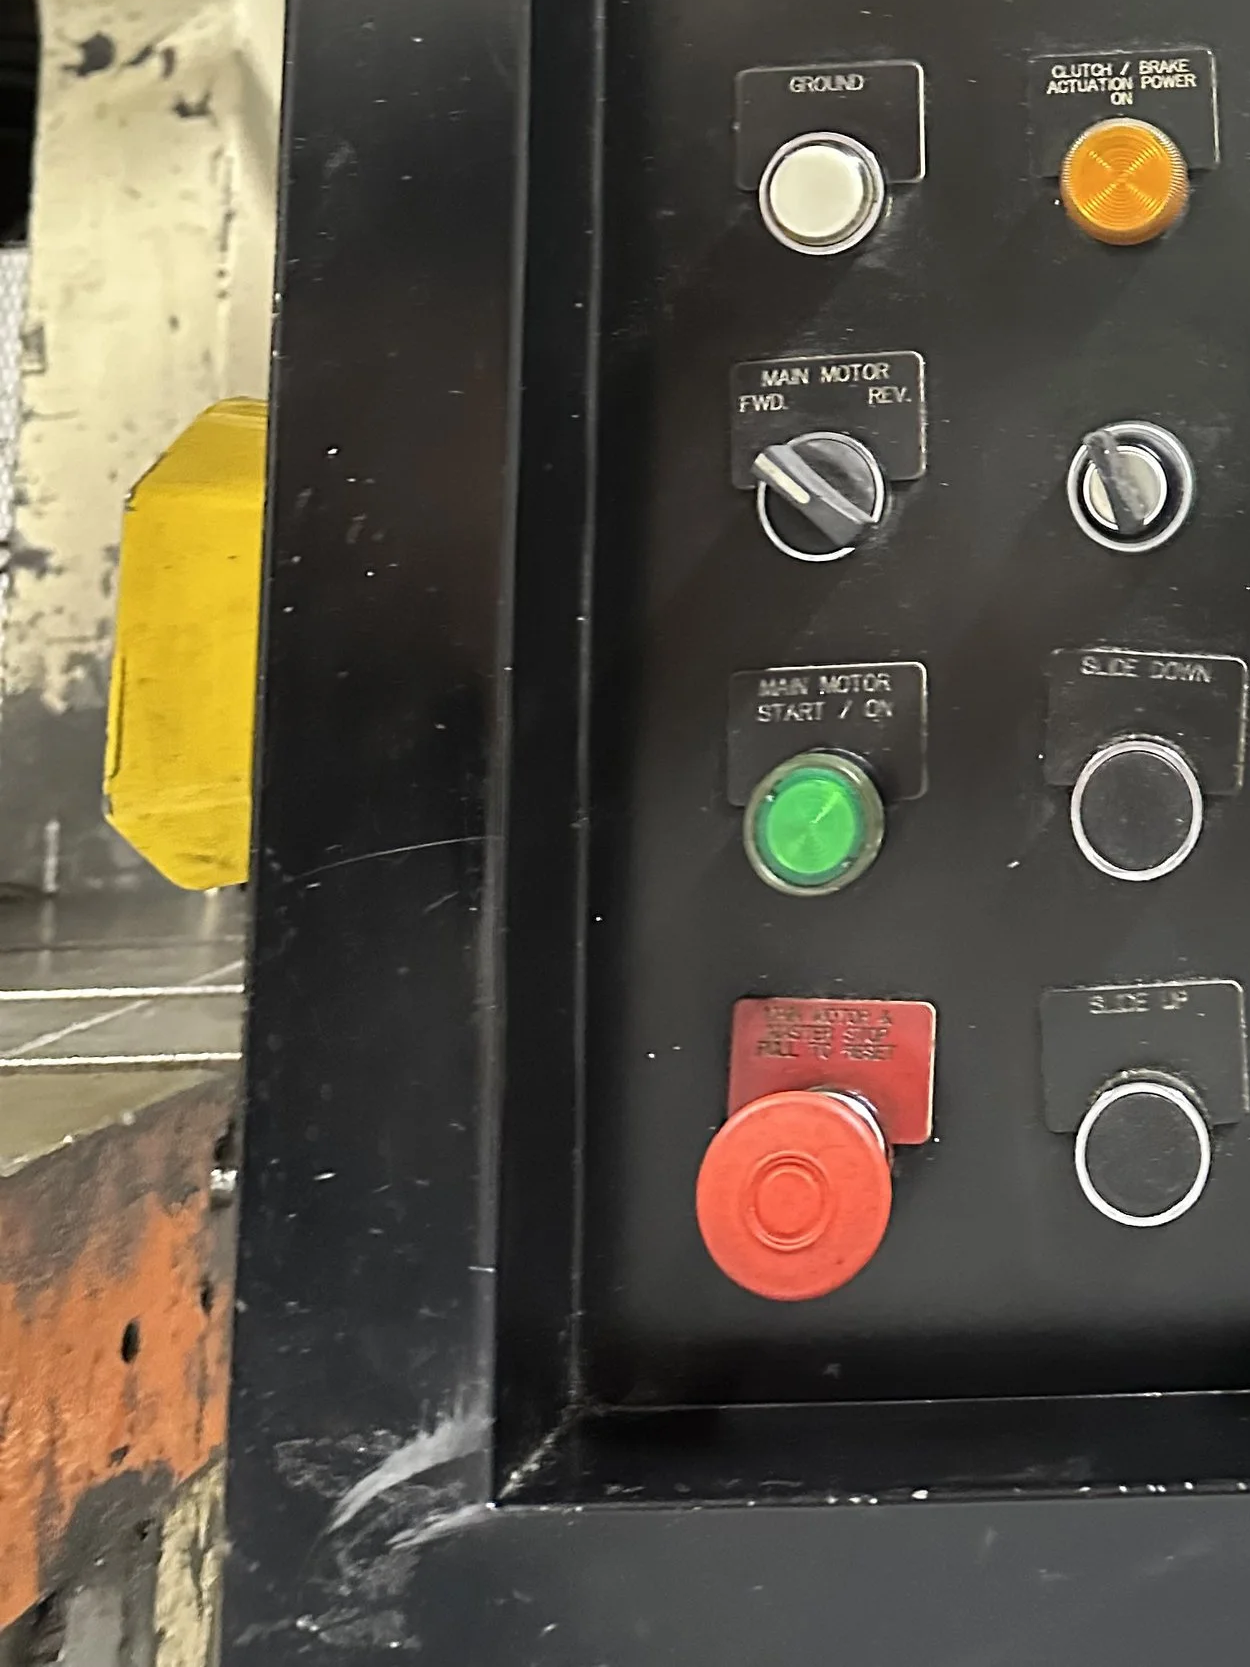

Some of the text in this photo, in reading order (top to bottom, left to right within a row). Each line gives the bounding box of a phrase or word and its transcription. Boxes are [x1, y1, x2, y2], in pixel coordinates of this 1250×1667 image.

[1051, 59, 1190, 80] CLUTCH / BRAKE
[789, 74, 865, 93] GROUND
[1047, 73, 1198, 95] ACTUATION POWER
[1110, 91, 1133, 106] ON
[760, 362, 890, 388] MAIN MOTOR
[738, 393, 789, 413] FWD.
[868, 386, 912, 405] REV.
[1149, 661, 1212, 684] DOWN
[758, 672, 892, 697] MAIN MOTOR
[757, 701, 826, 724] START
[863, 698, 895, 719] ON
